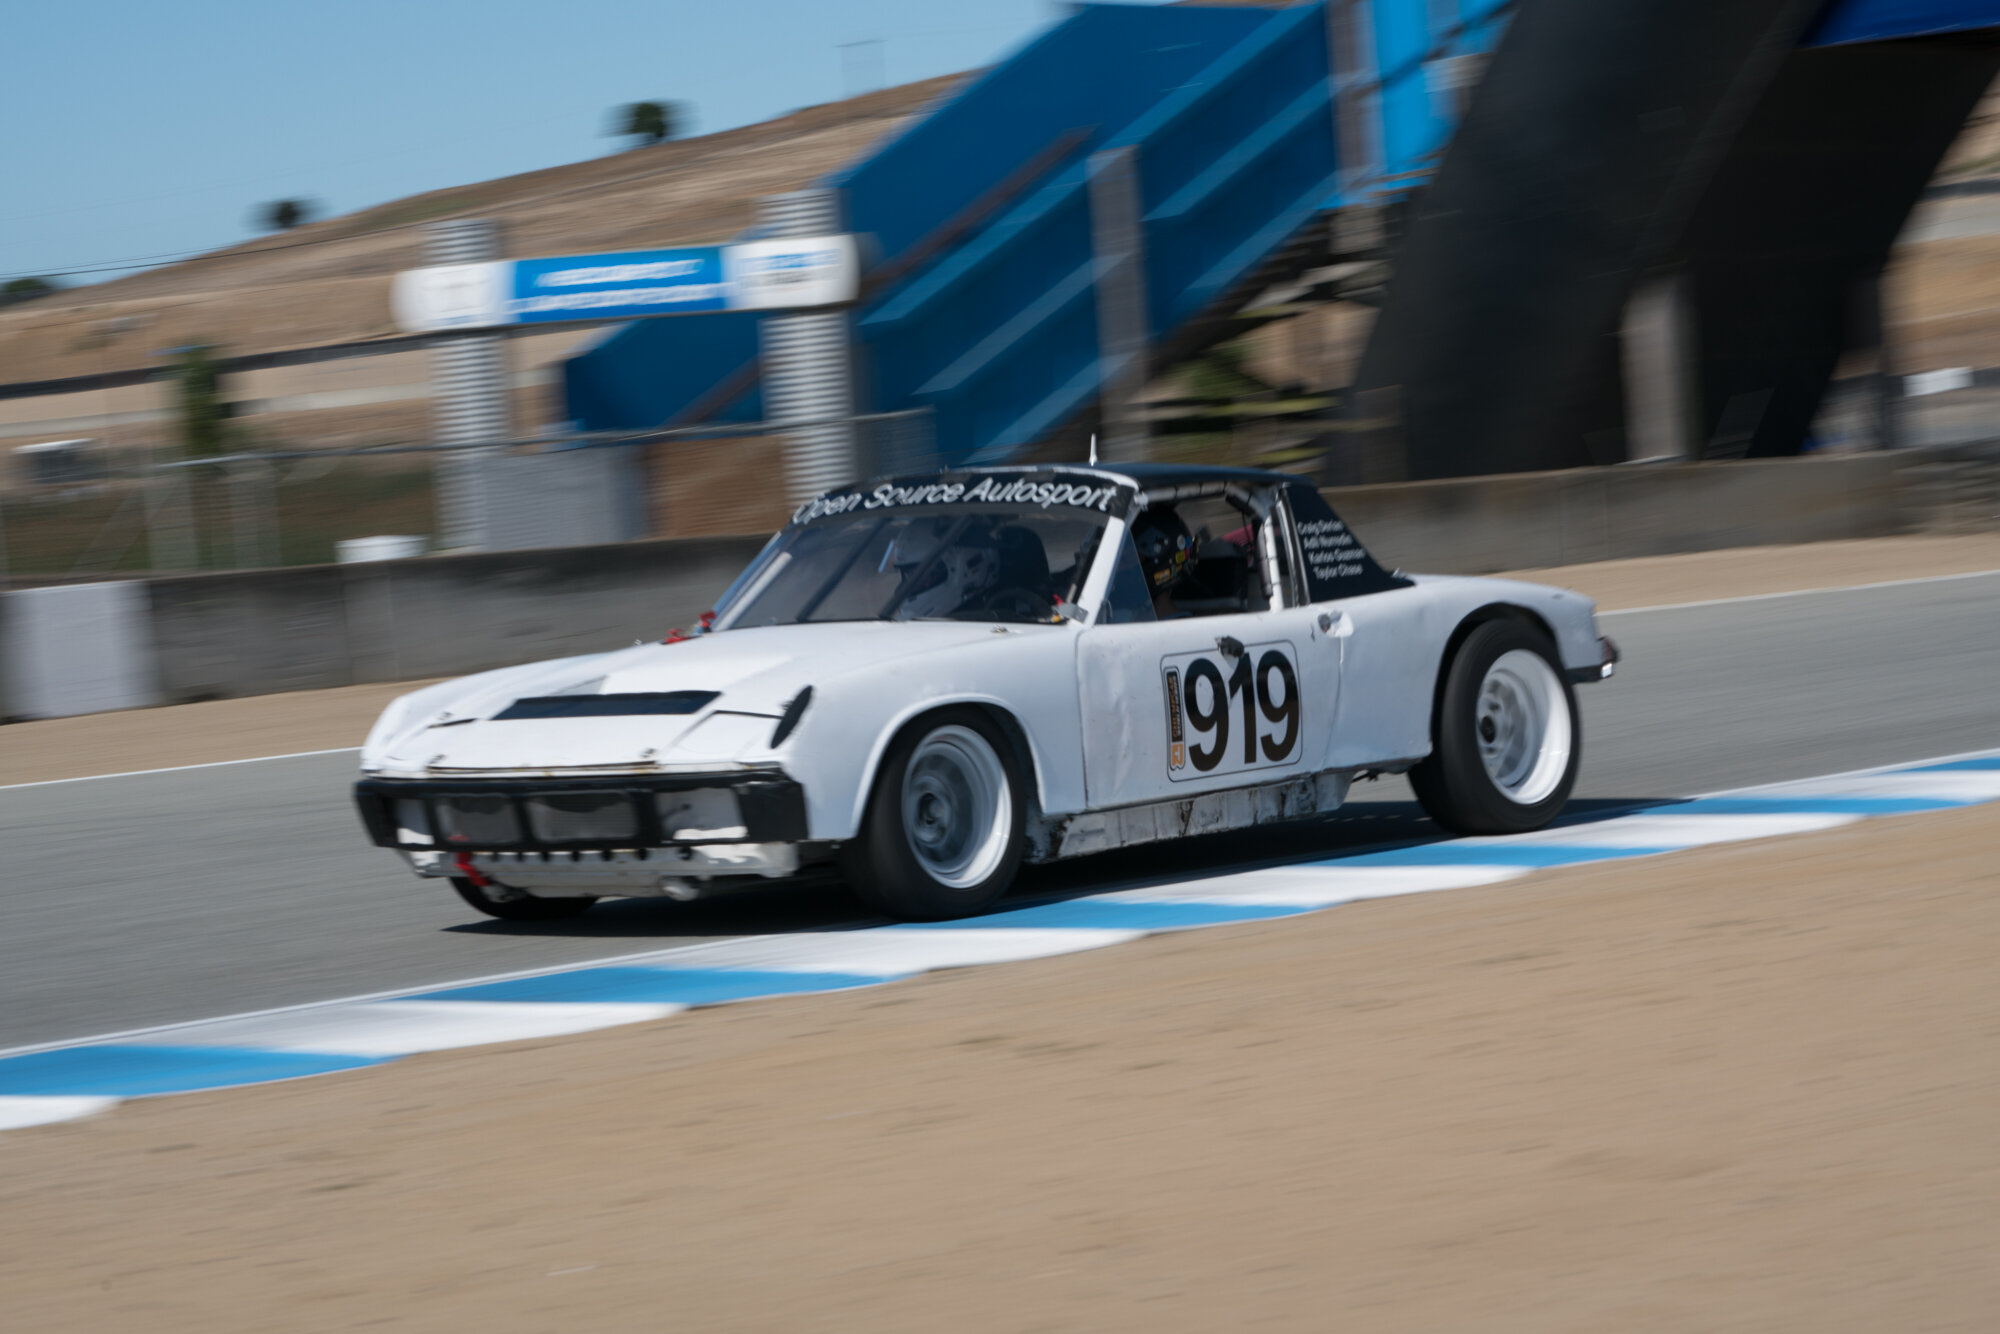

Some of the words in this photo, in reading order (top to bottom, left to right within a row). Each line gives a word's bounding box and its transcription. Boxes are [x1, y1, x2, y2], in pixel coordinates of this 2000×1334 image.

[792, 492, 863, 525] Open
[863, 483, 966, 510] Source
[962, 476, 1118, 512] Autosport
[1184, 648, 1300, 773] 919
